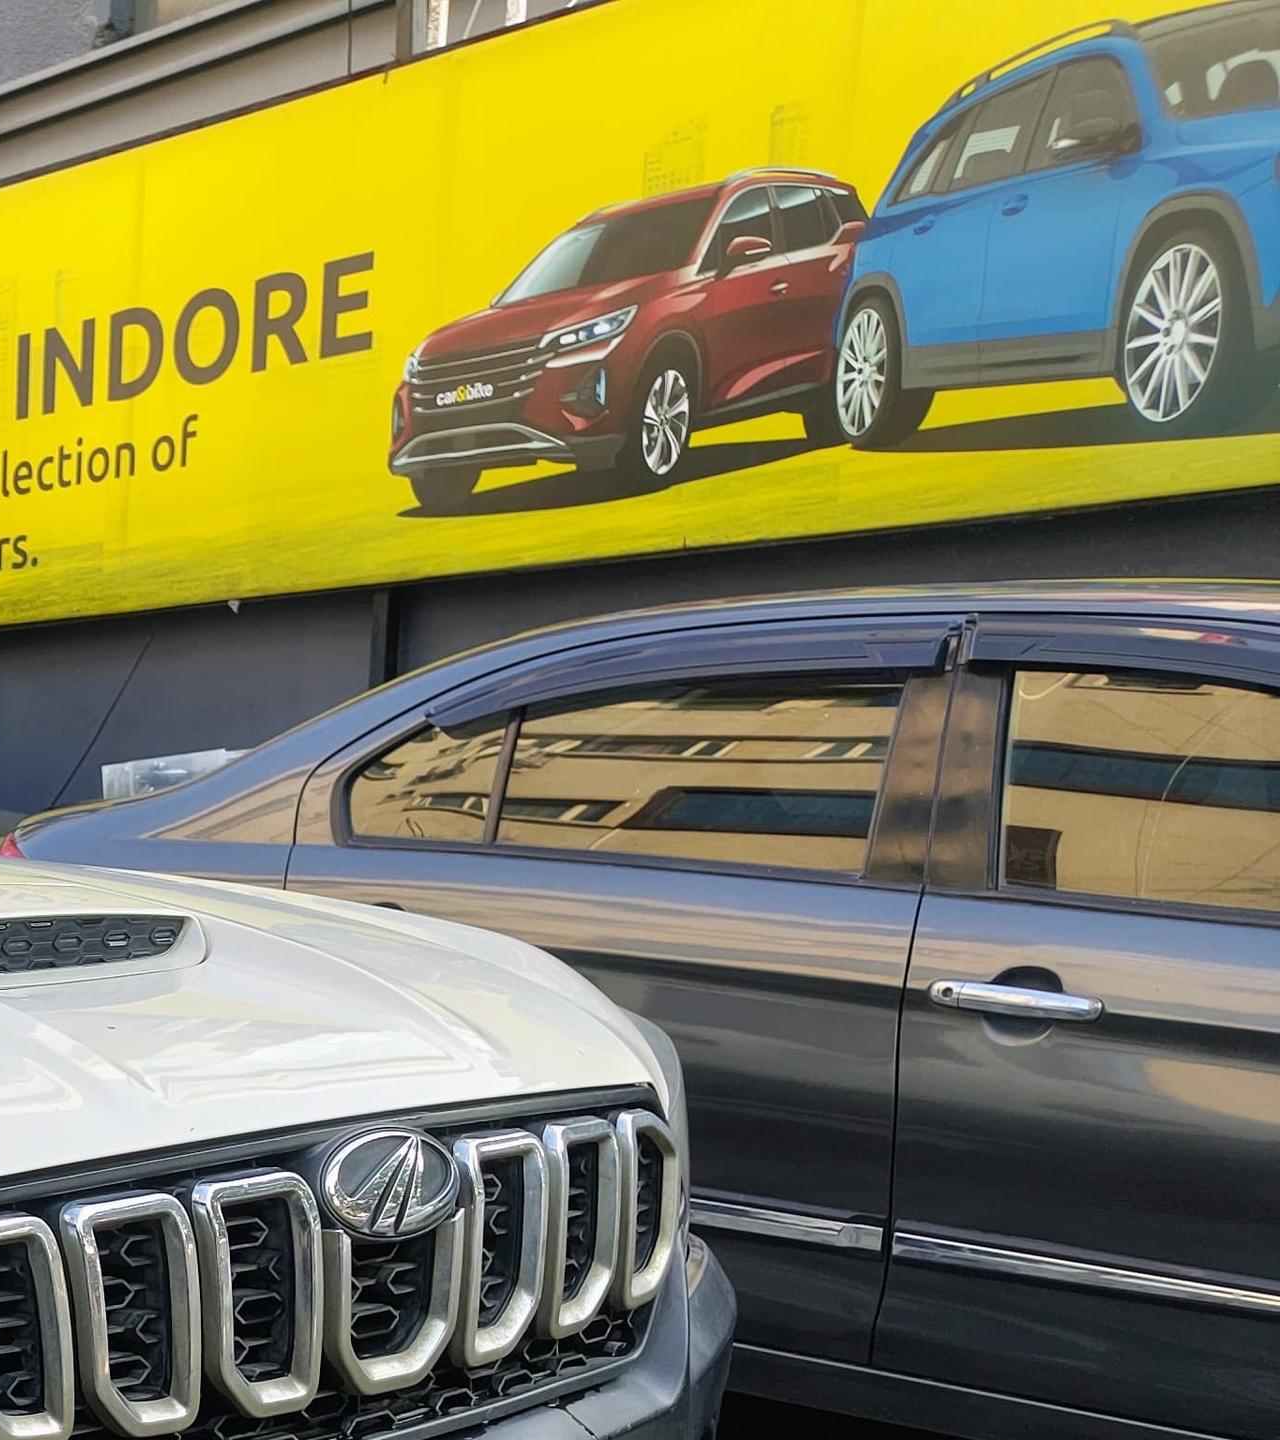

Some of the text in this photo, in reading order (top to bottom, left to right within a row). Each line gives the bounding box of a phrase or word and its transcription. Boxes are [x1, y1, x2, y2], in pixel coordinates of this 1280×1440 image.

[16, 251, 375, 421] INDORE
[436, 382, 494, 407] car&bike
[151, 414, 198, 471] of
